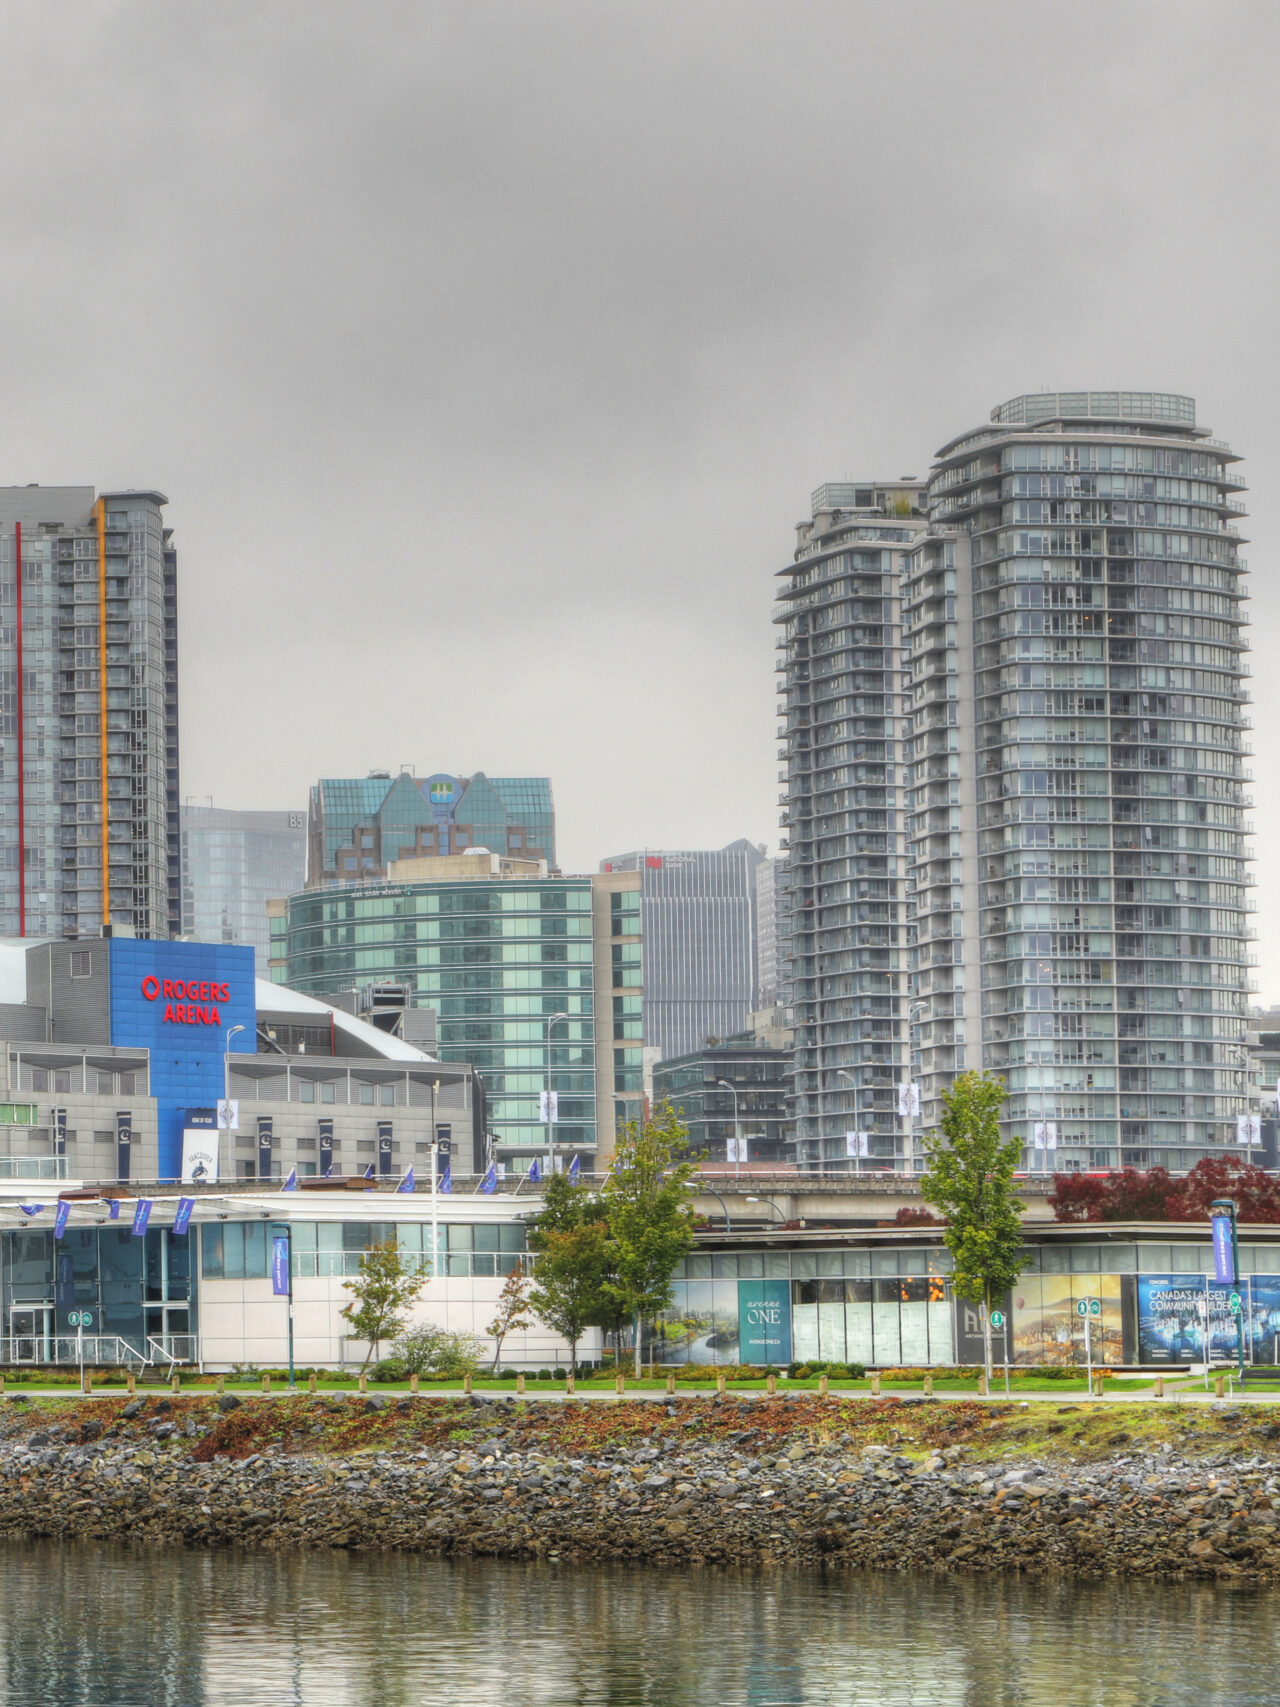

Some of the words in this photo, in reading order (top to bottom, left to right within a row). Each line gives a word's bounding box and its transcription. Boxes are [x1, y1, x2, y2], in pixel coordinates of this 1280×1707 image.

[163, 979, 231, 1002] ROGERS
[163, 1003, 221, 1025] ARENA
[188, 1152, 214, 1164] VANCOUVER
[1149, 1290, 1192, 1300] CANADA'S
[1193, 1290, 1227, 1300] LARGEST
[747, 1309, 781, 1324] ONE
